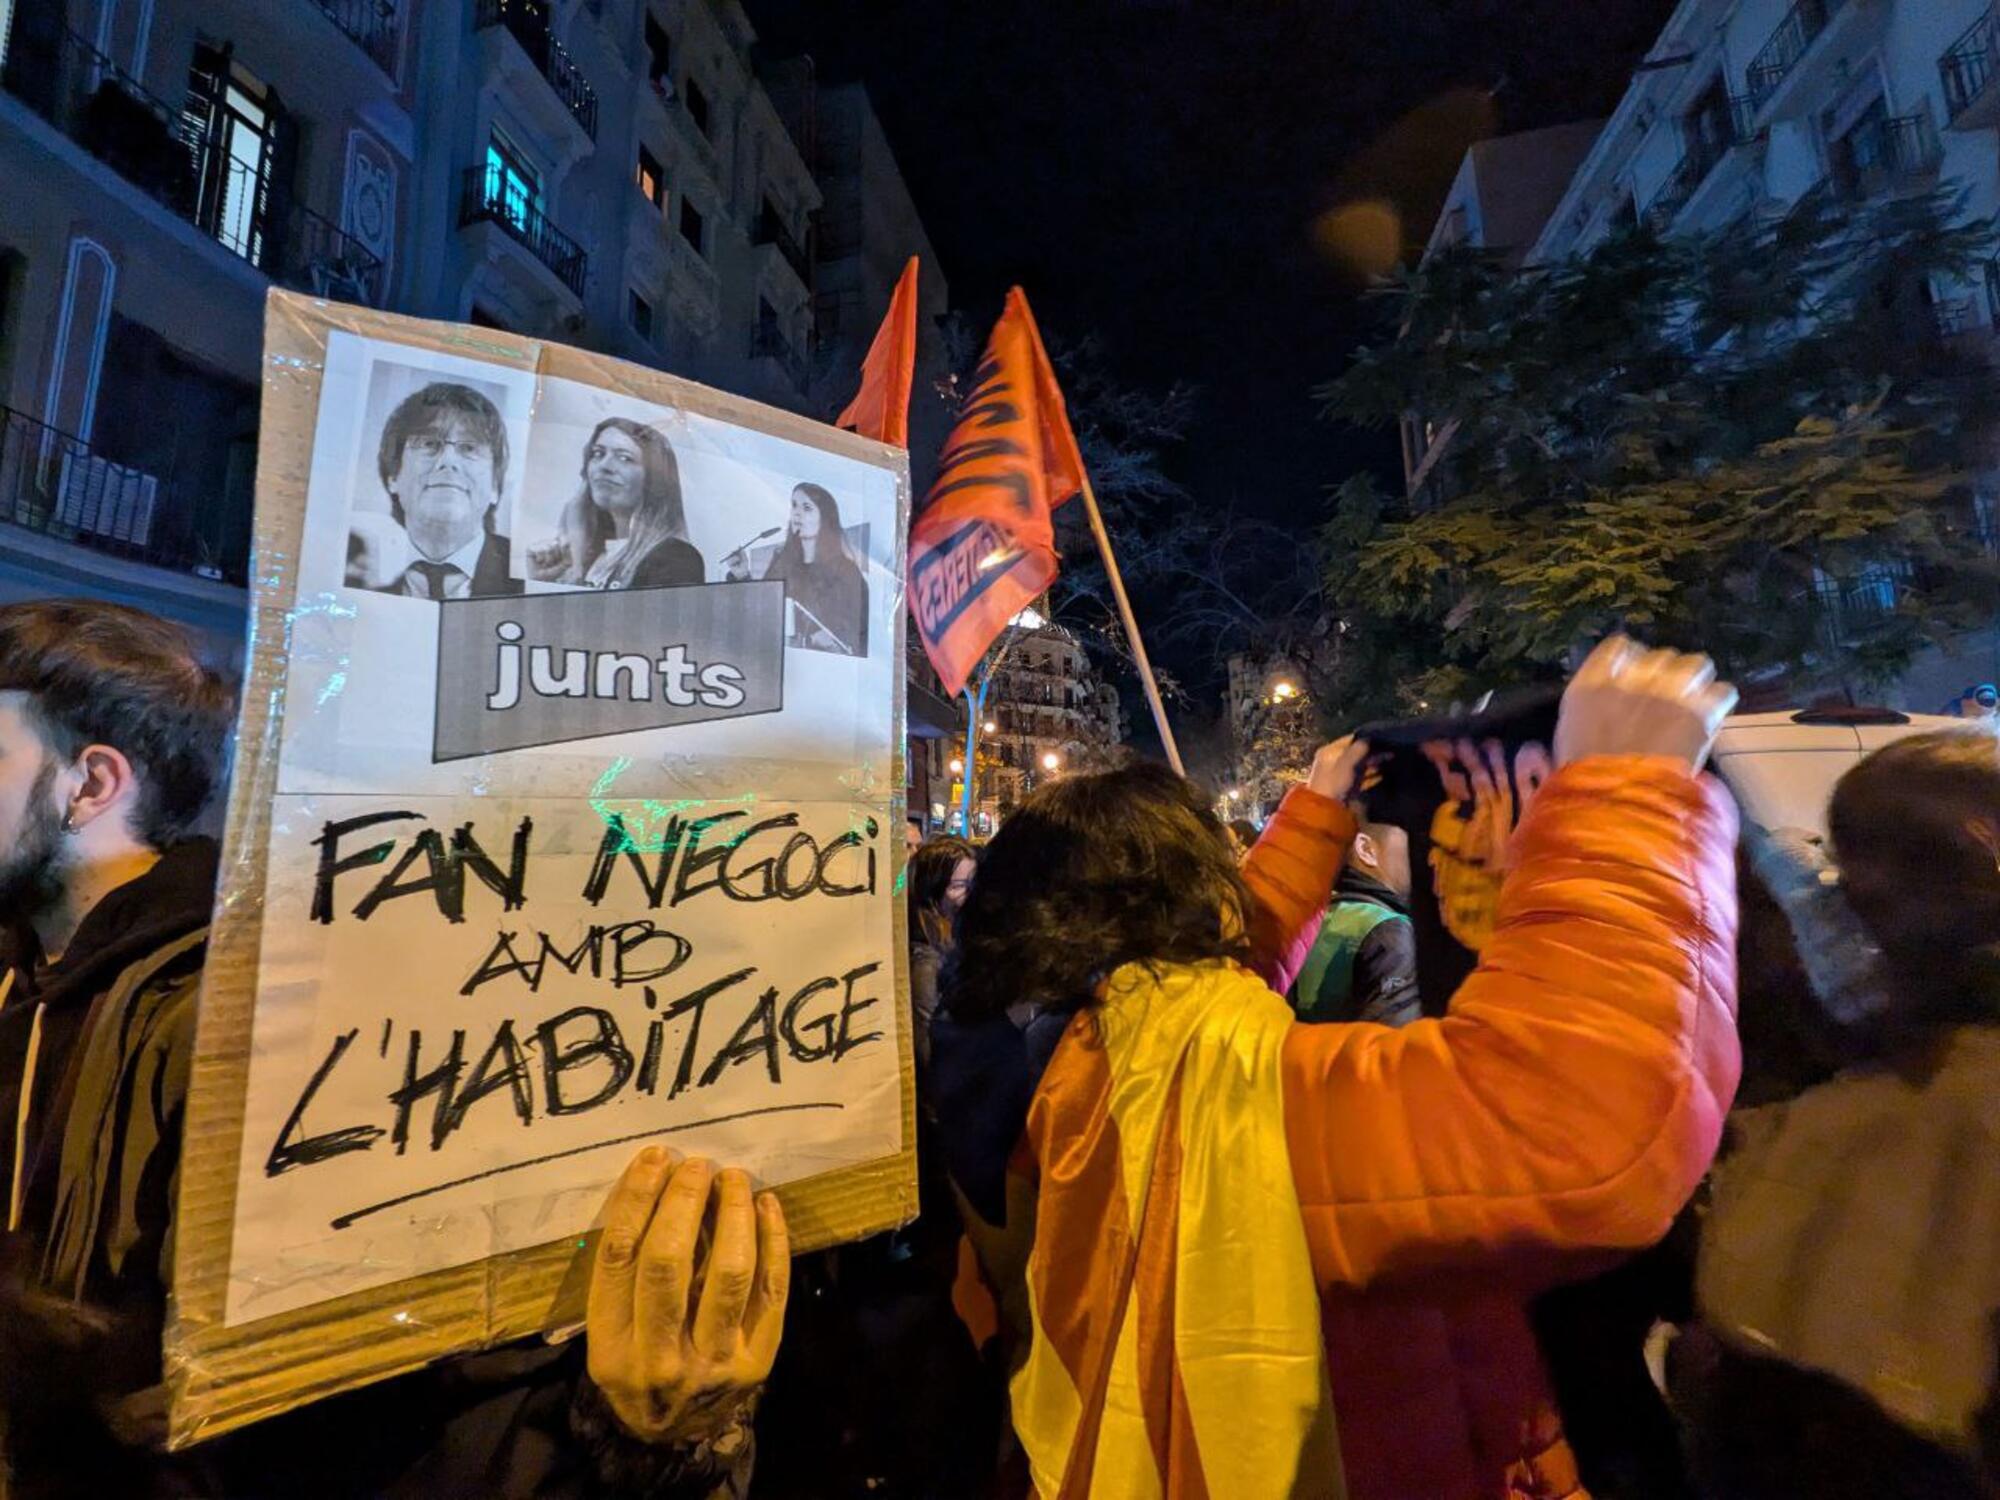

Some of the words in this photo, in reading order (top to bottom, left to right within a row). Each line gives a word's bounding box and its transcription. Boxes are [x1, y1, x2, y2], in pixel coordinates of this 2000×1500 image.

[486, 621, 746, 711] junts
[311, 811, 533, 924] FAN
[460, 920, 692, 995] AMB
